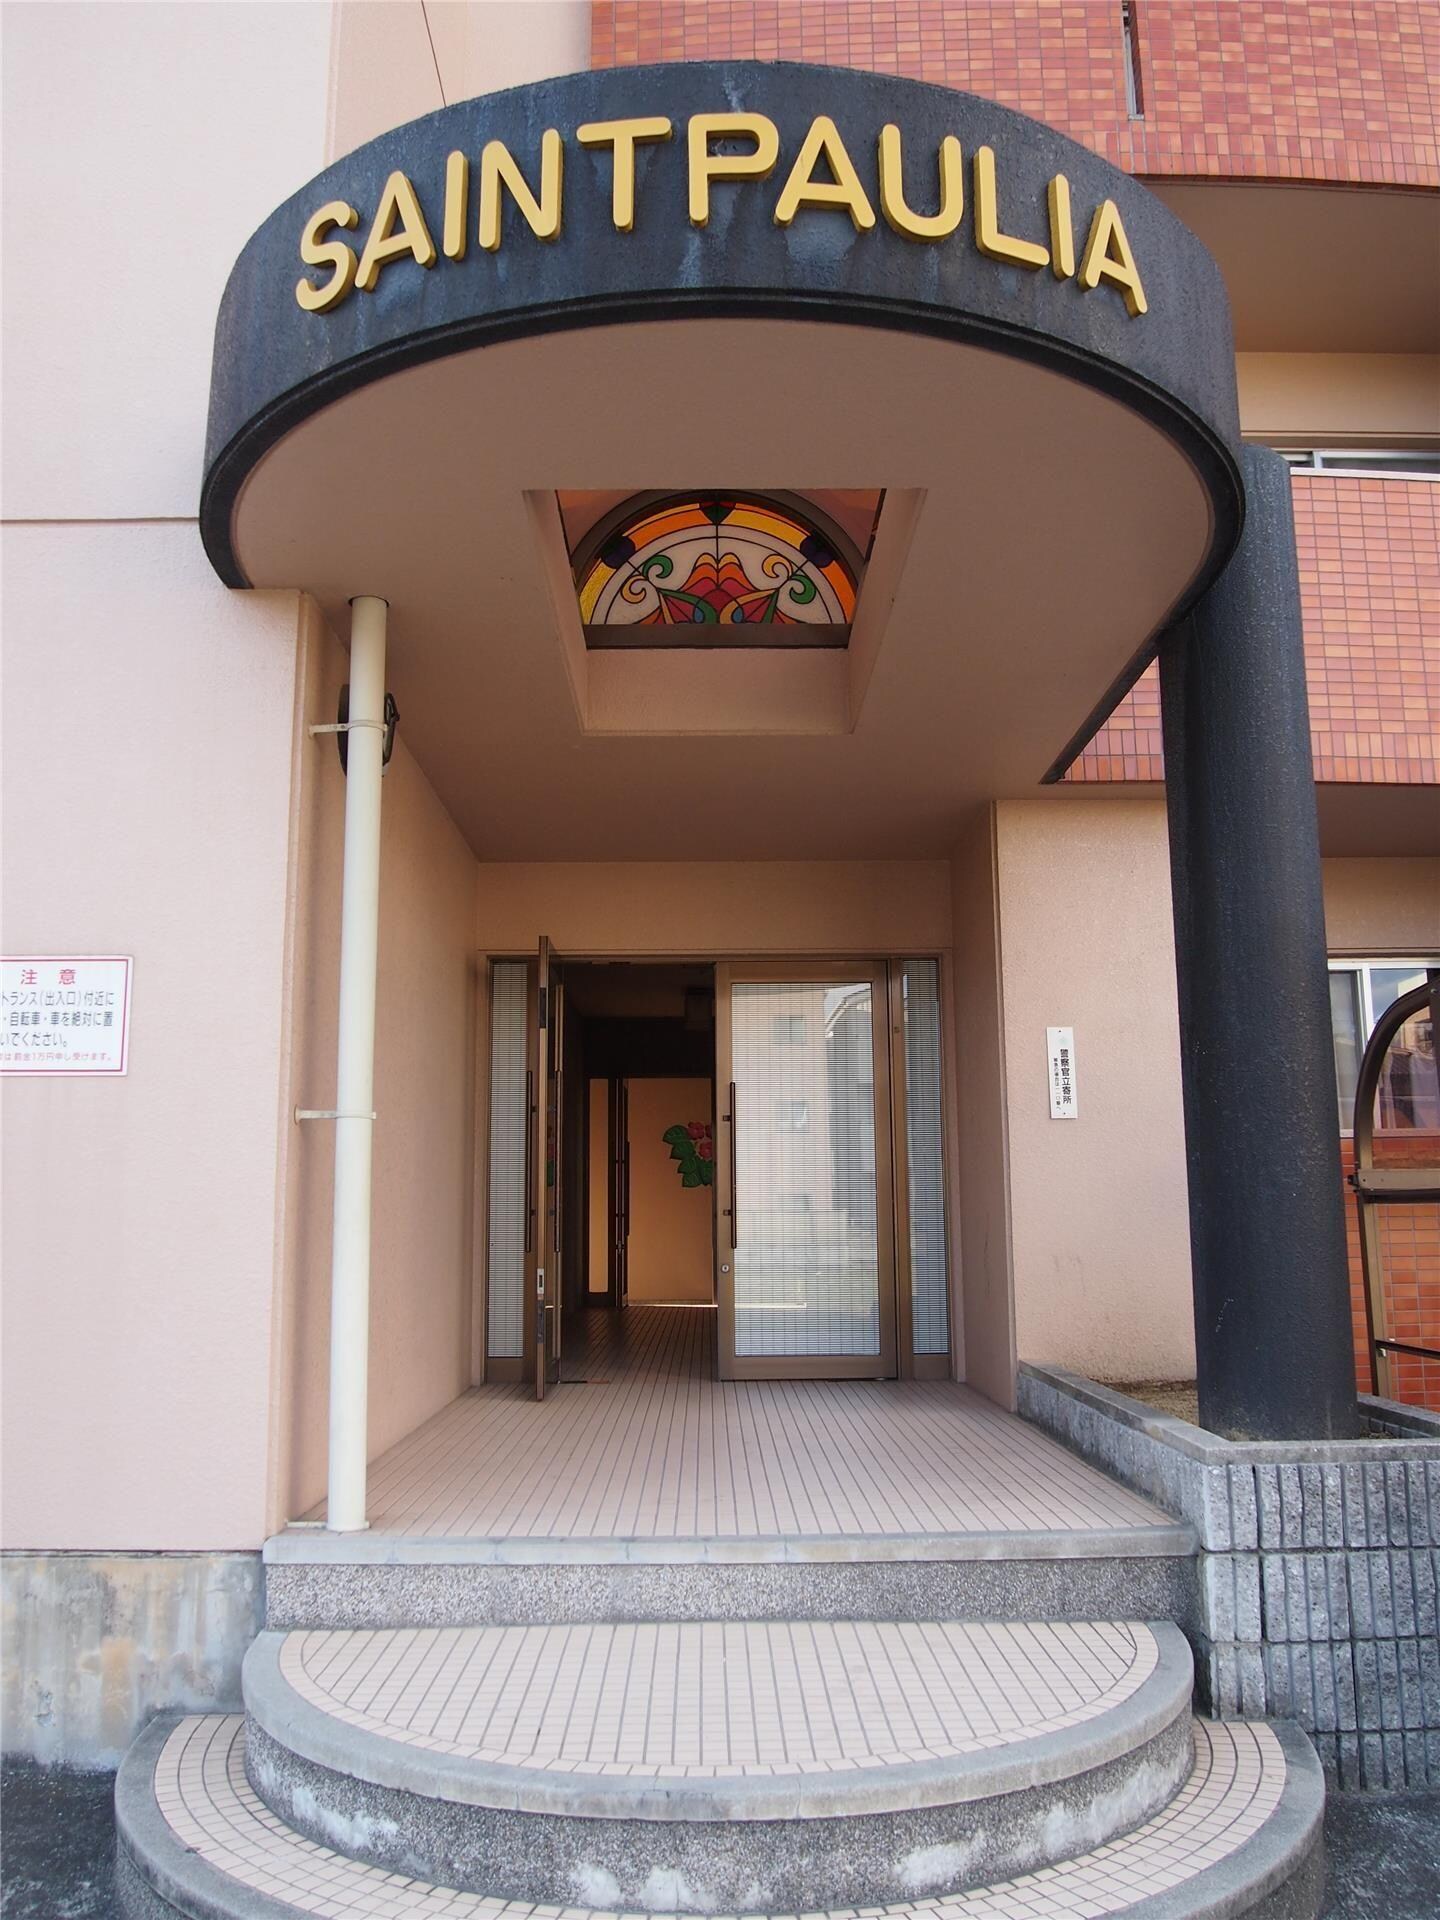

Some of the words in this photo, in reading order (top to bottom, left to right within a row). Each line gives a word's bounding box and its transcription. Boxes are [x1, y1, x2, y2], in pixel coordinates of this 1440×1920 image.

[295, 112, 1148, 318] SAINTPAULIA
[1060, 1049, 1072, 1104] 警察官立寄所
